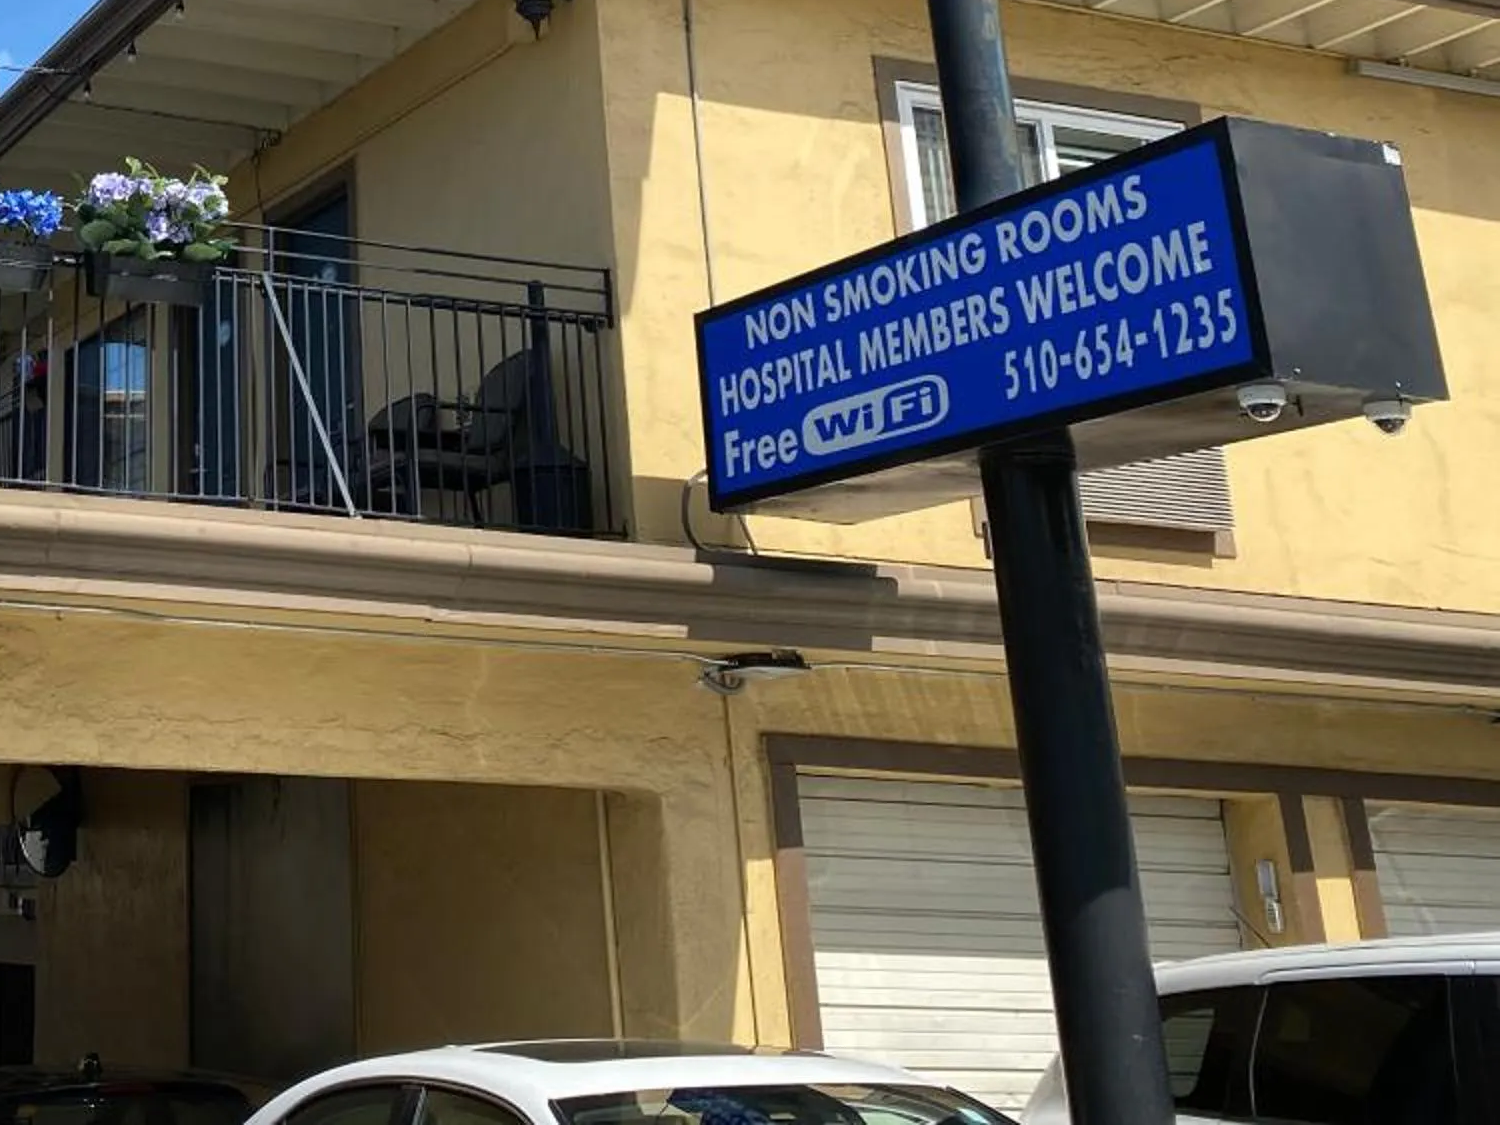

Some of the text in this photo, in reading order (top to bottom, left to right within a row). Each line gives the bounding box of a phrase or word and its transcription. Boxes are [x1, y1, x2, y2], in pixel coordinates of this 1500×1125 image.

[719, 221, 1213, 418] HOSPITAL MEMBERS WELCOME
[744, 174, 1148, 349] NON SMOKING ROOMS
[1004, 289, 1238, 401] 510-654-1235
[724, 428, 799, 477] Free
